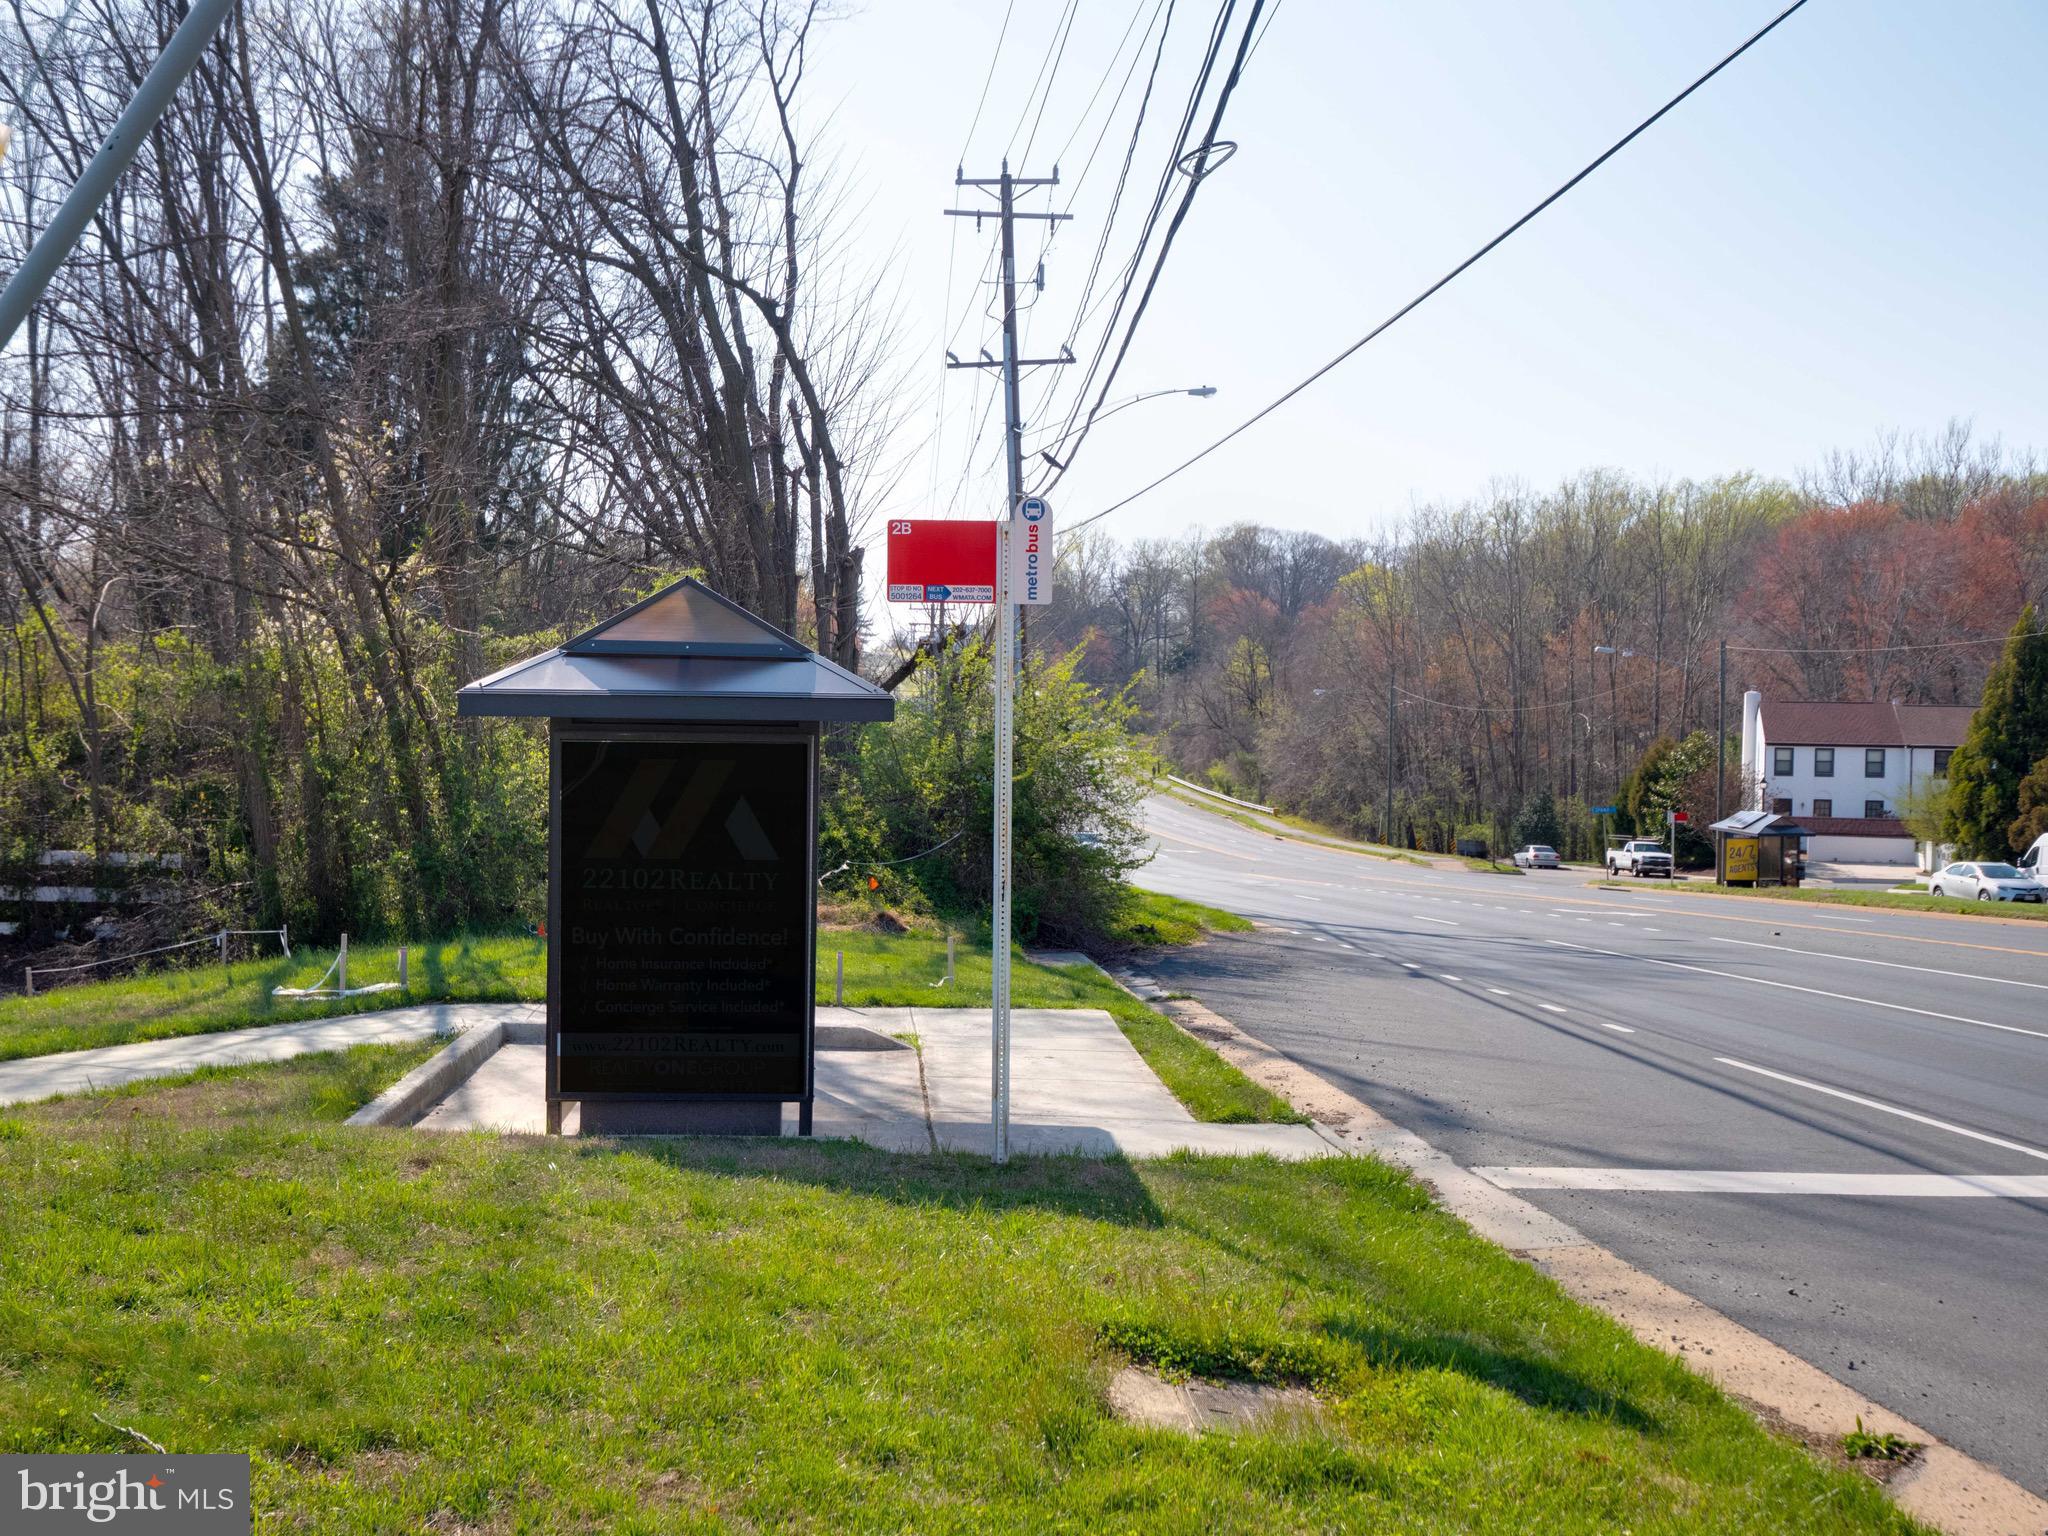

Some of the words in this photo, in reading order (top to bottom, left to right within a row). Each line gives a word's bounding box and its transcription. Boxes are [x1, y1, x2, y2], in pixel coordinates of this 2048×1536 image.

[892, 522, 912, 535] 2B
[1025, 524, 1039, 600] metrobus
[891, 592, 922, 600] 5001264
[582, 867, 780, 891] 22102REALTY
[571, 926, 609, 949] Buy
[615, 927, 662, 945] With
[669, 926, 789, 945] Confidence!
[595, 957, 637, 970] Home
[641, 957, 705, 970] Insurance
[595, 978, 637, 992] Home
[640, 978, 701, 995] Warranty
[594, 1000, 664, 1016] Concierge
[668, 1000, 719, 1014] Service
